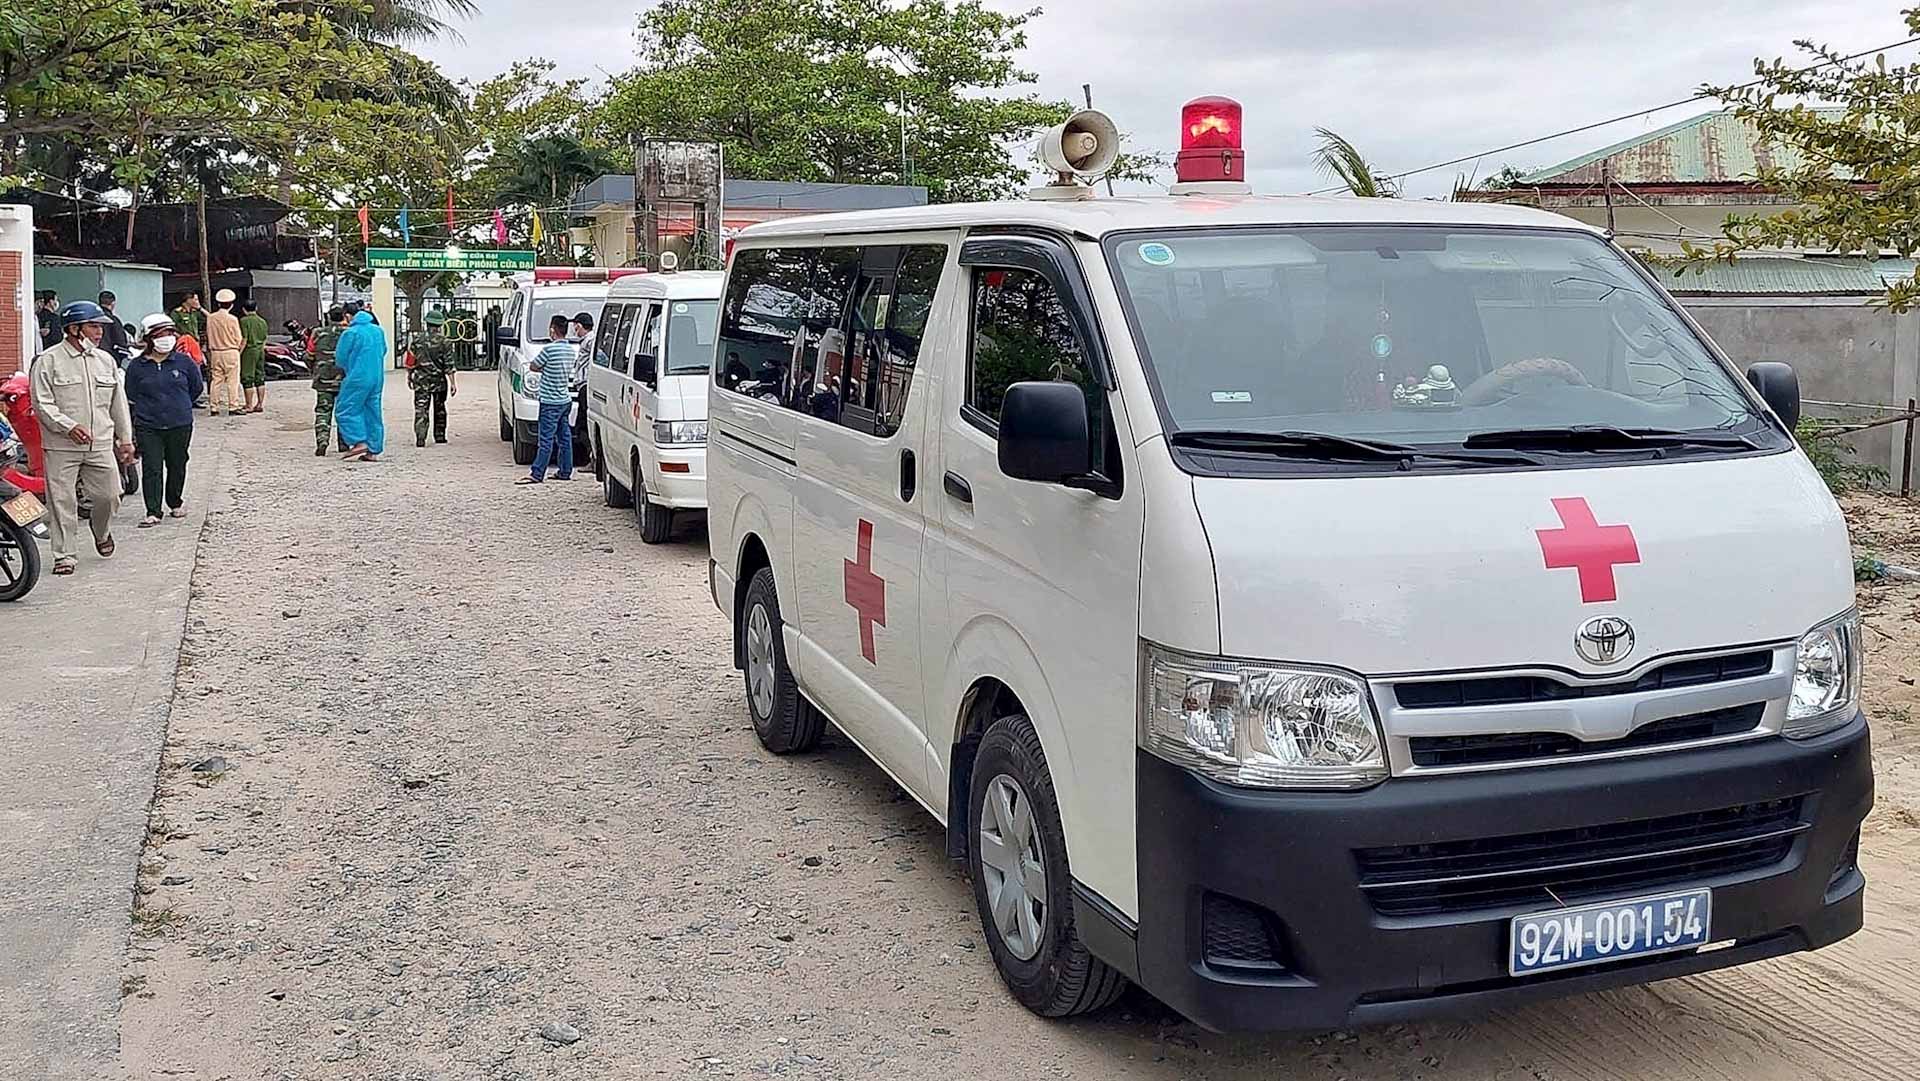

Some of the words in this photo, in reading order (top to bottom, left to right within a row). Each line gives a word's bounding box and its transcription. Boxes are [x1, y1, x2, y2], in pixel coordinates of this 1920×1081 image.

[370, 259, 396, 269] TRẠM
[397, 257, 421, 268] KIỂM
[422, 258, 445, 268] SOÁT
[446, 259, 468, 269] BIÊN
[468, 260, 498, 269] PHÒNG
[499, 258, 518, 269] CỬA
[519, 261, 534, 270] ĐẠI
[1519, 897, 1702, 967] 92M-001.54
